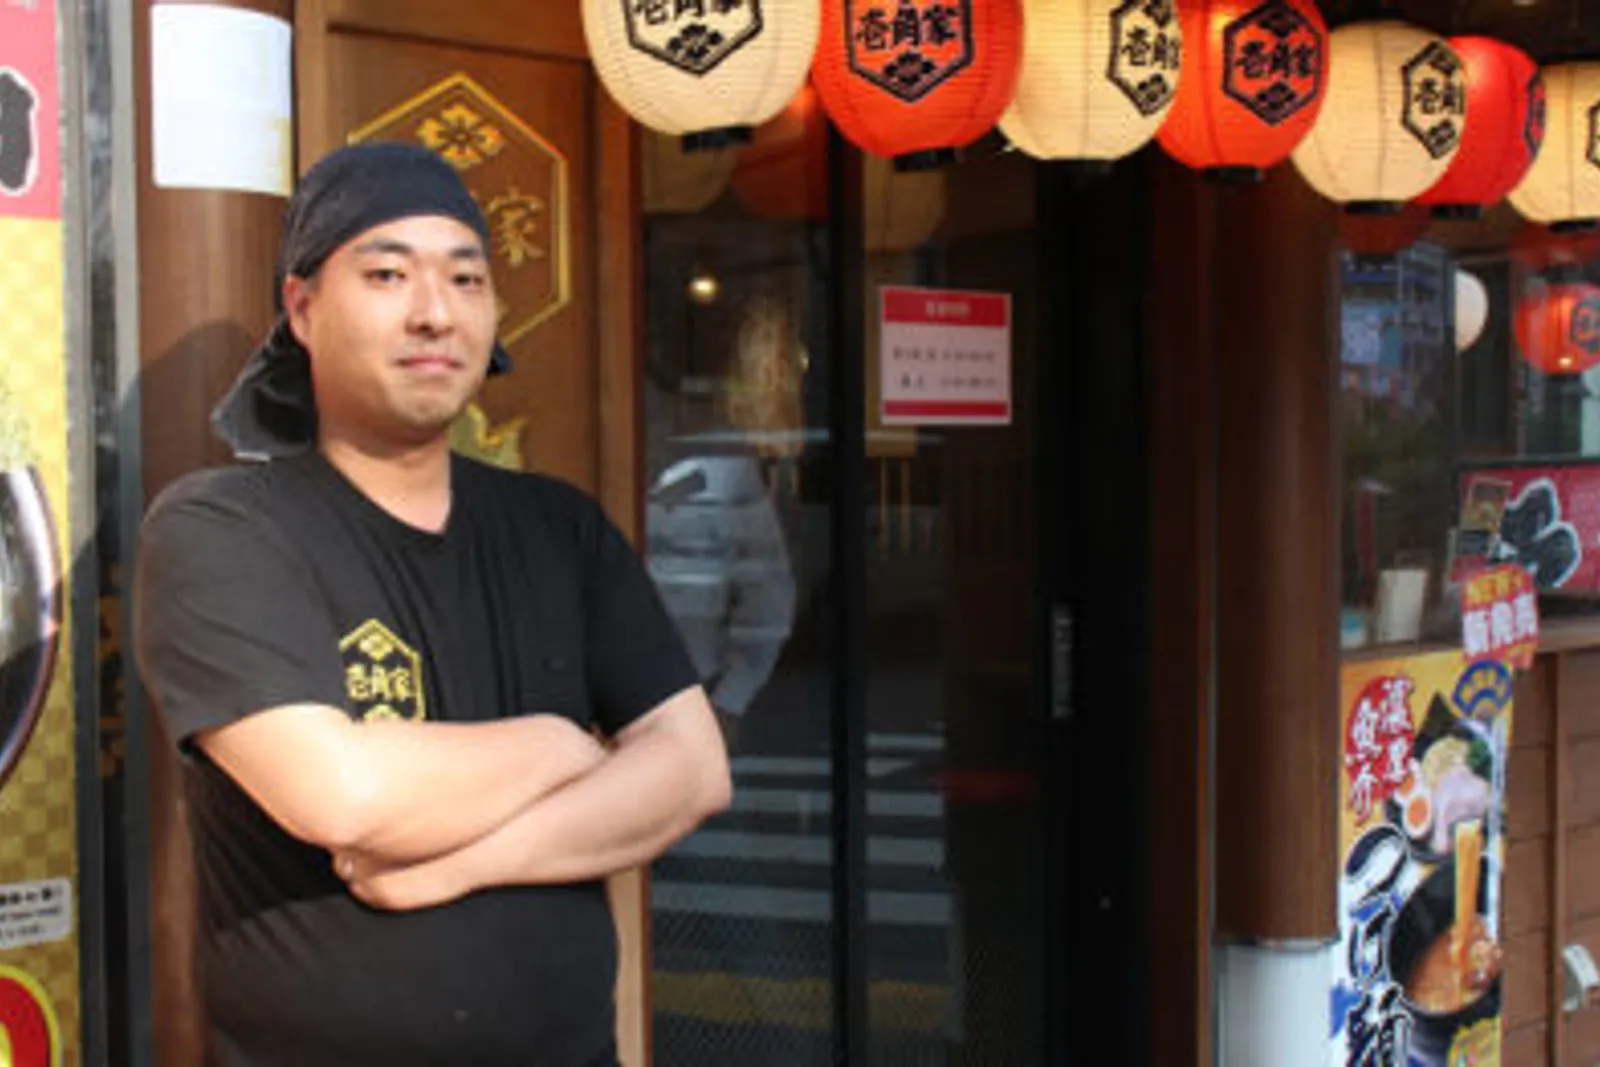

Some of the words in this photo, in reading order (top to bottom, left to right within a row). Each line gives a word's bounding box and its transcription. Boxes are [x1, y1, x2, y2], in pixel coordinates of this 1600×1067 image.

[856, 1, 957, 50] 壱角家
[1235, 40, 1317, 78] 壱角家
[346, 662, 416, 702] 壱角家
